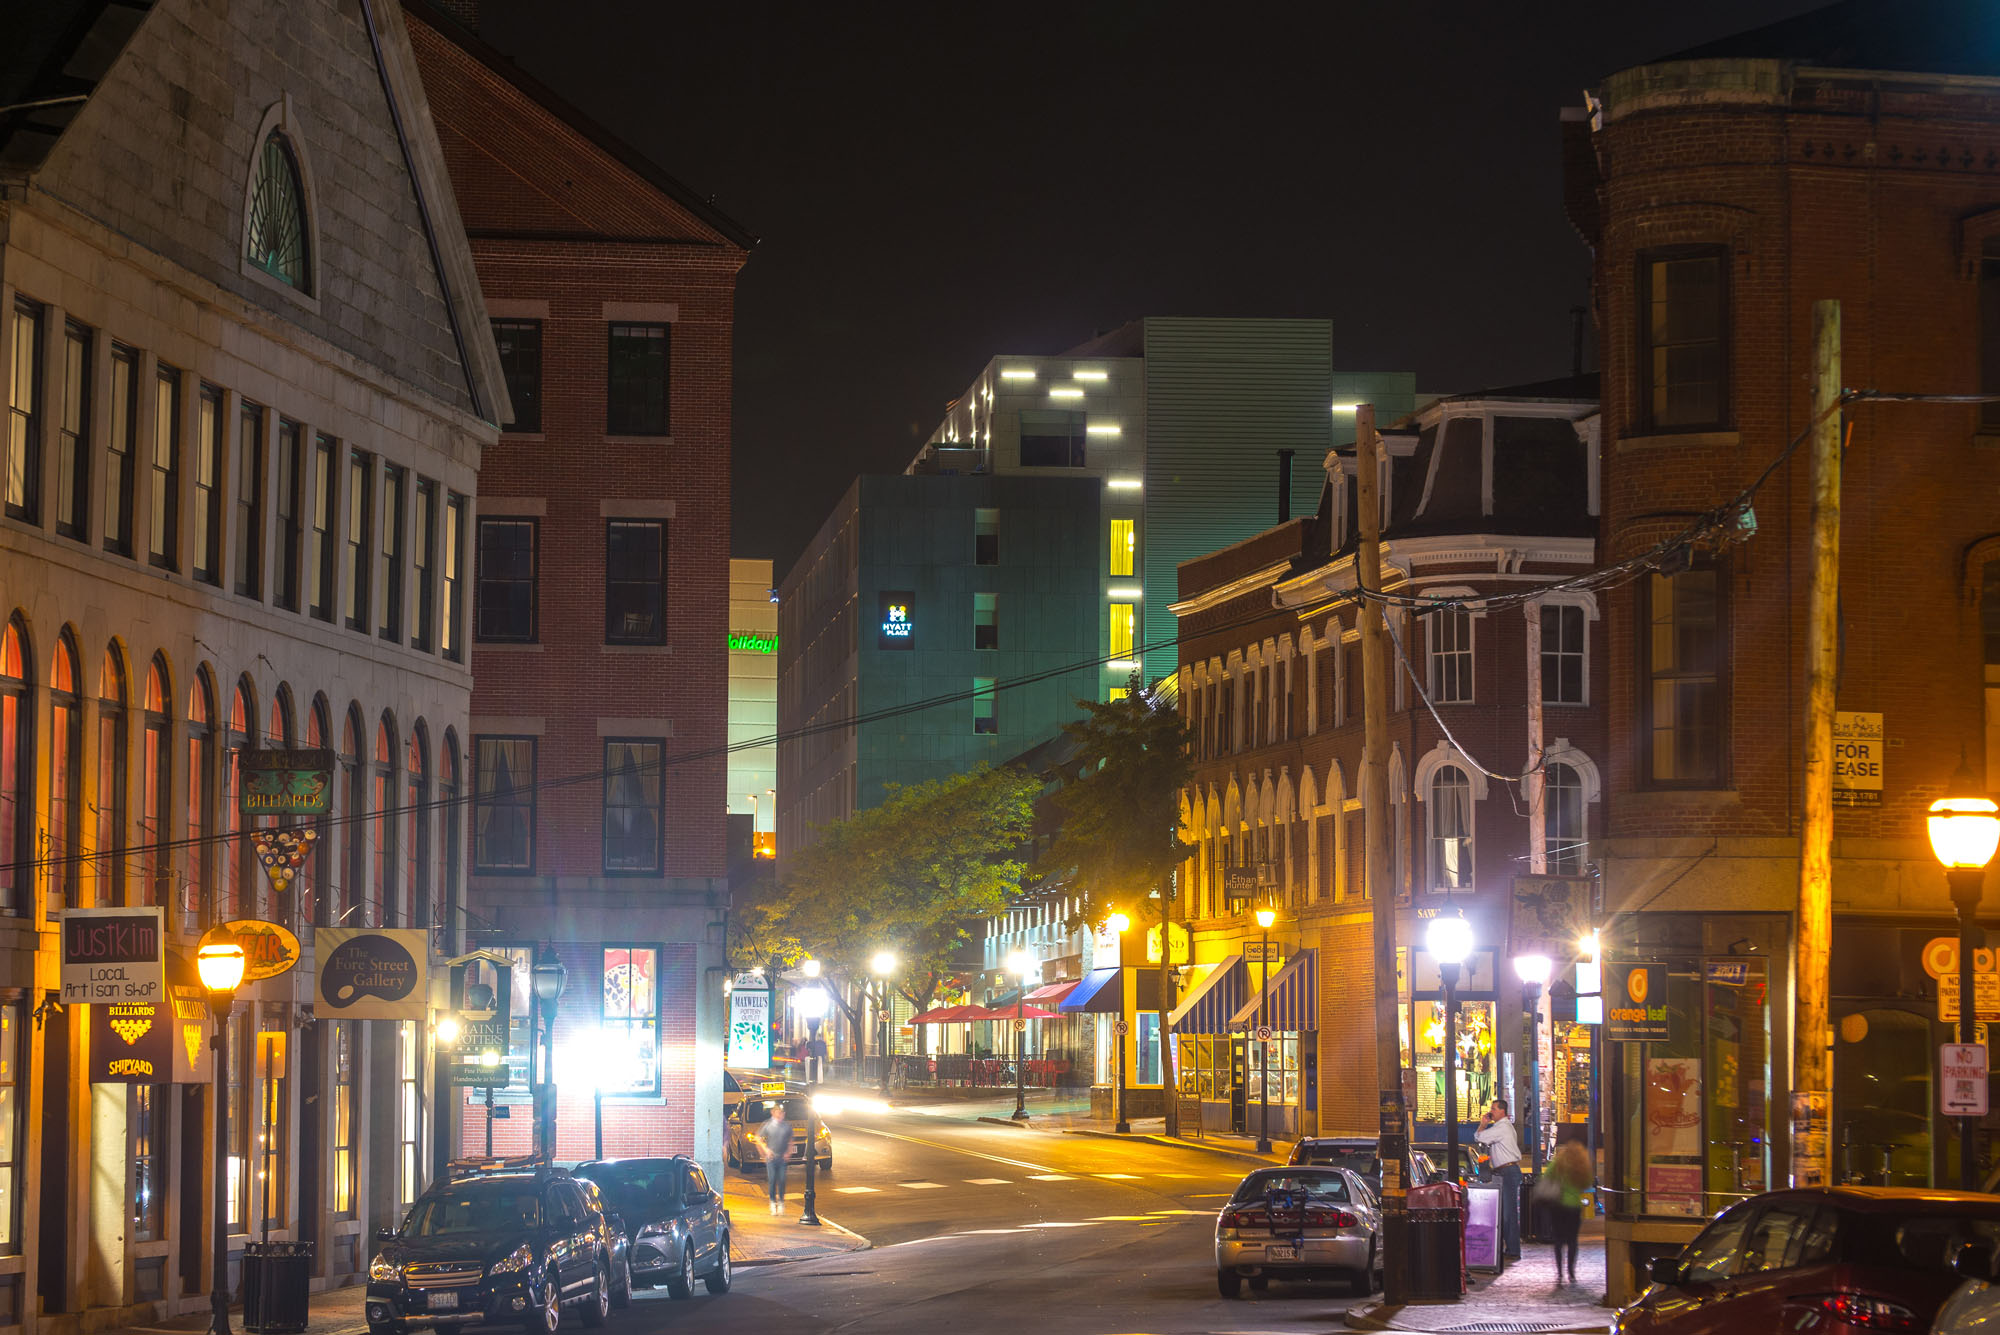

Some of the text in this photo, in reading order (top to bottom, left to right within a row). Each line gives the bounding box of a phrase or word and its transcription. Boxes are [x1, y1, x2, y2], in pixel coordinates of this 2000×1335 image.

[882, 623, 912, 631] HYATT
[1835, 743, 1870, 759] FOR
[1832, 761, 1879, 777] EASE
[247, 793, 324, 808] BILLIARDS
[1225, 879, 1254, 889] Hunter
[1231, 873, 1257, 884] Ethan
[347, 947, 368, 959] The
[335, 957, 409, 971] Fore Street
[353, 973, 405, 990] Gallery
[1948, 976, 1960, 986] NO
[735, 996, 768, 1008] MAXWELL'S
[108, 1006, 155, 1016] BILLIARDS
[1610, 1004, 1667, 1023] orange leaf
[457, 1034, 503, 1045] POTTERS
[1955, 1051, 1973, 1064] NO
[108, 1058, 153, 1076] SHIPYARD
[1944, 1066, 1985, 1080] PARKING
